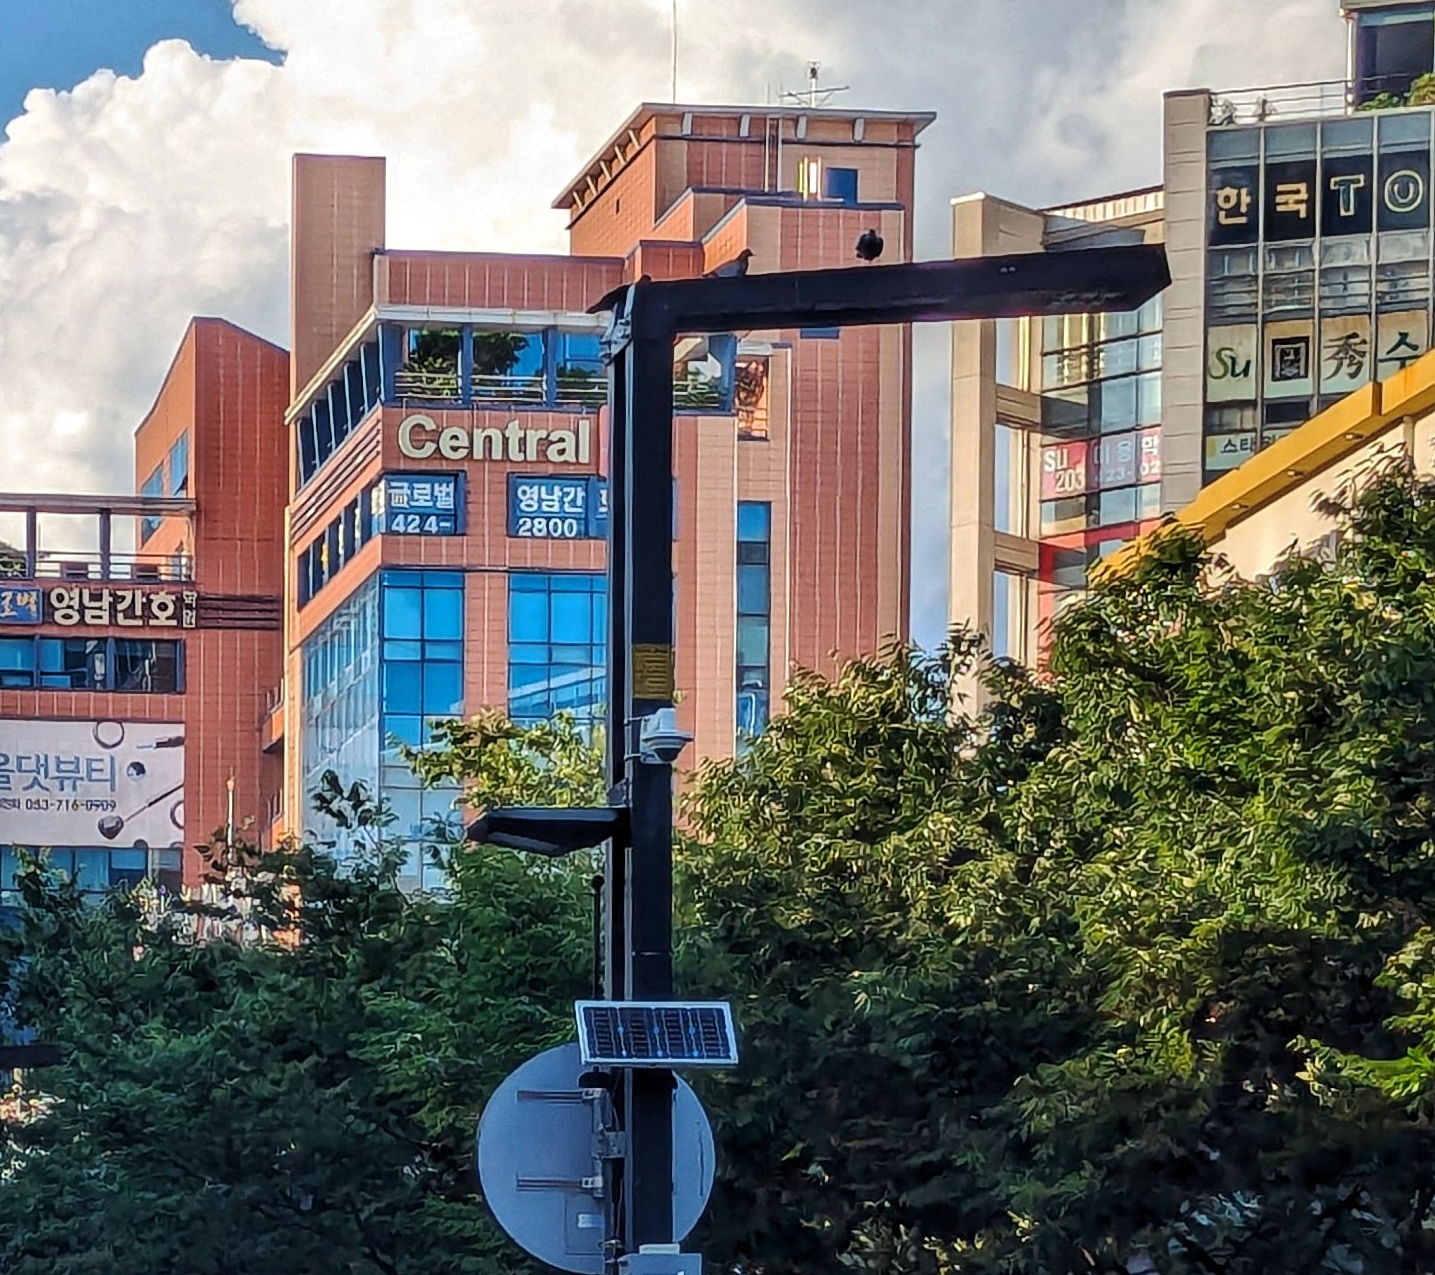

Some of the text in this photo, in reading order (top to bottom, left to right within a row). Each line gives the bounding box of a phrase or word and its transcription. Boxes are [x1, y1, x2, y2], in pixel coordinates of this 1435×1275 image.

[398, 414, 591, 464] Central
[388, 481, 455, 509] 글로벌
[391, 514, 578, 538] 424- 2800
[50, 585, 179, 626] 영남간호
